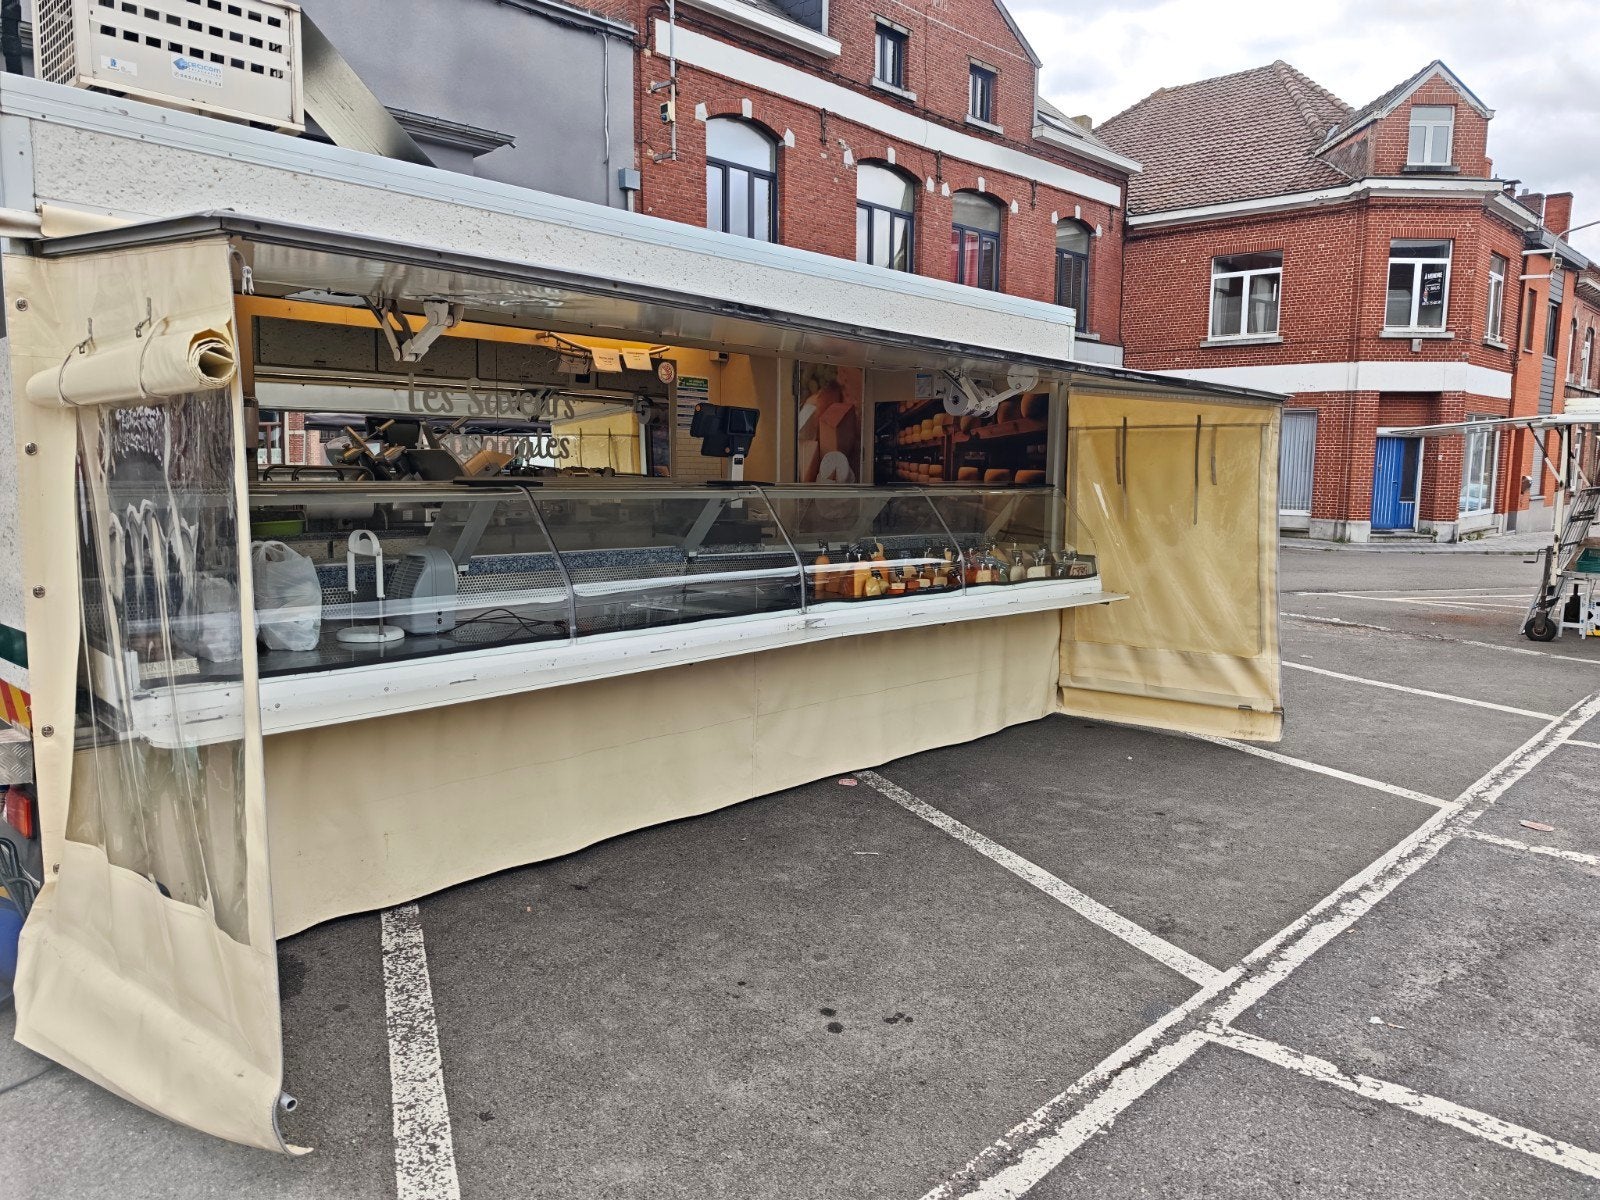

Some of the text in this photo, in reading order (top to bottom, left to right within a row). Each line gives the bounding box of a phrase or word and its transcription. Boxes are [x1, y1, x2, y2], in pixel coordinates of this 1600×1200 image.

[408, 372, 576, 421] Les Saveurs
[415, 419, 570, 460] Atisanales
